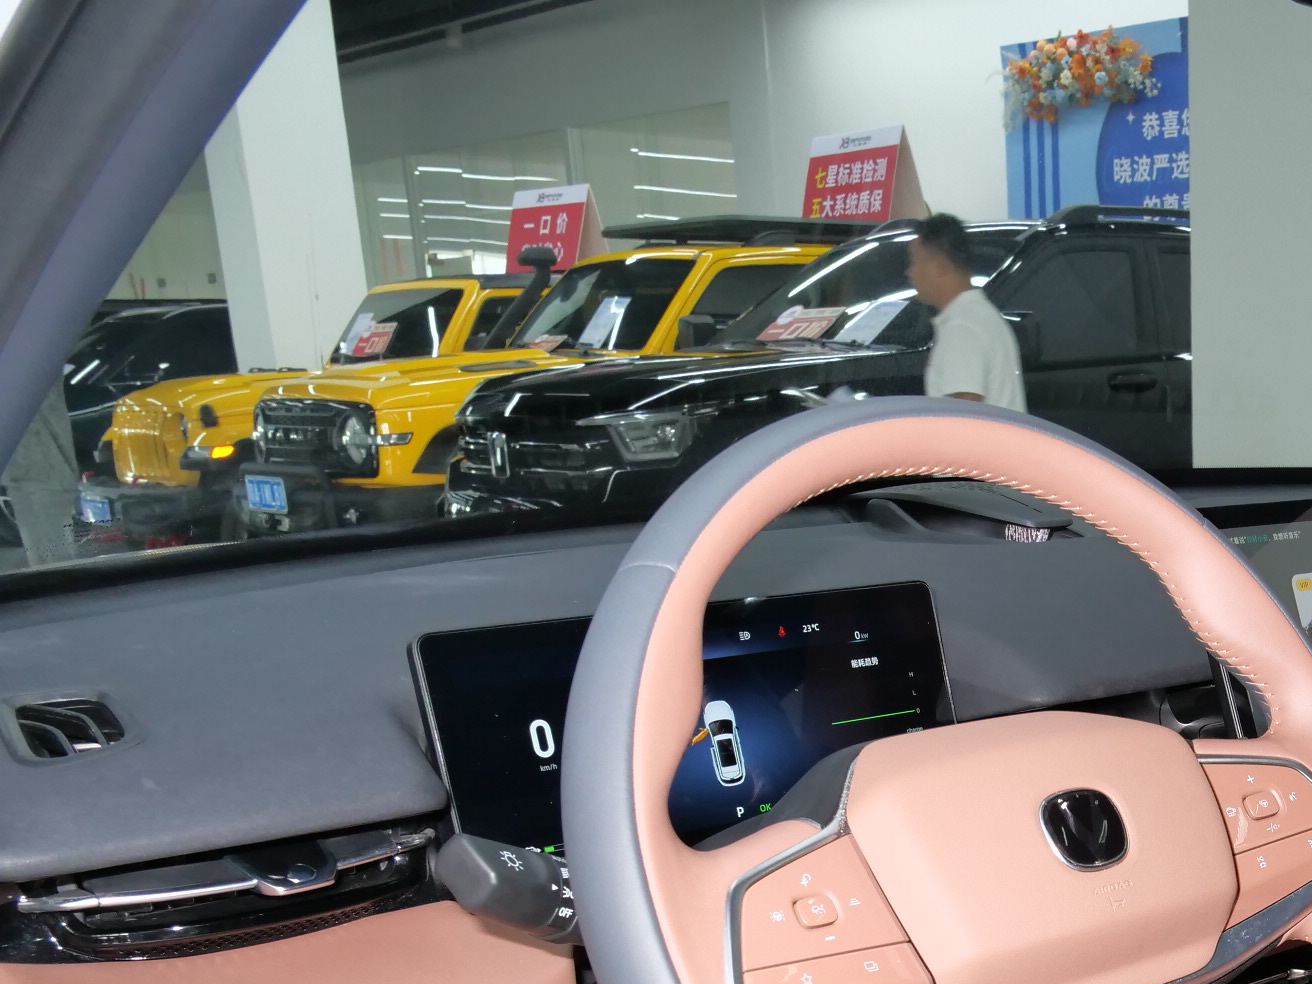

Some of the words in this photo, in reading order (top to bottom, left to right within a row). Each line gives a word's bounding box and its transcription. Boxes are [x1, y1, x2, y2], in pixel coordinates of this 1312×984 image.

[815, 157, 888, 188] 七星标准检测
[1113, 152, 1190, 184] 晓波严选
[810, 190, 883, 219] 五大系统质保
[529, 719, 555, 758] 0
[540, 763, 558, 772] km/h
[736, 806, 745, 818] P
[760, 802, 772, 813] OK
[558, 907, 574, 918] OFF
